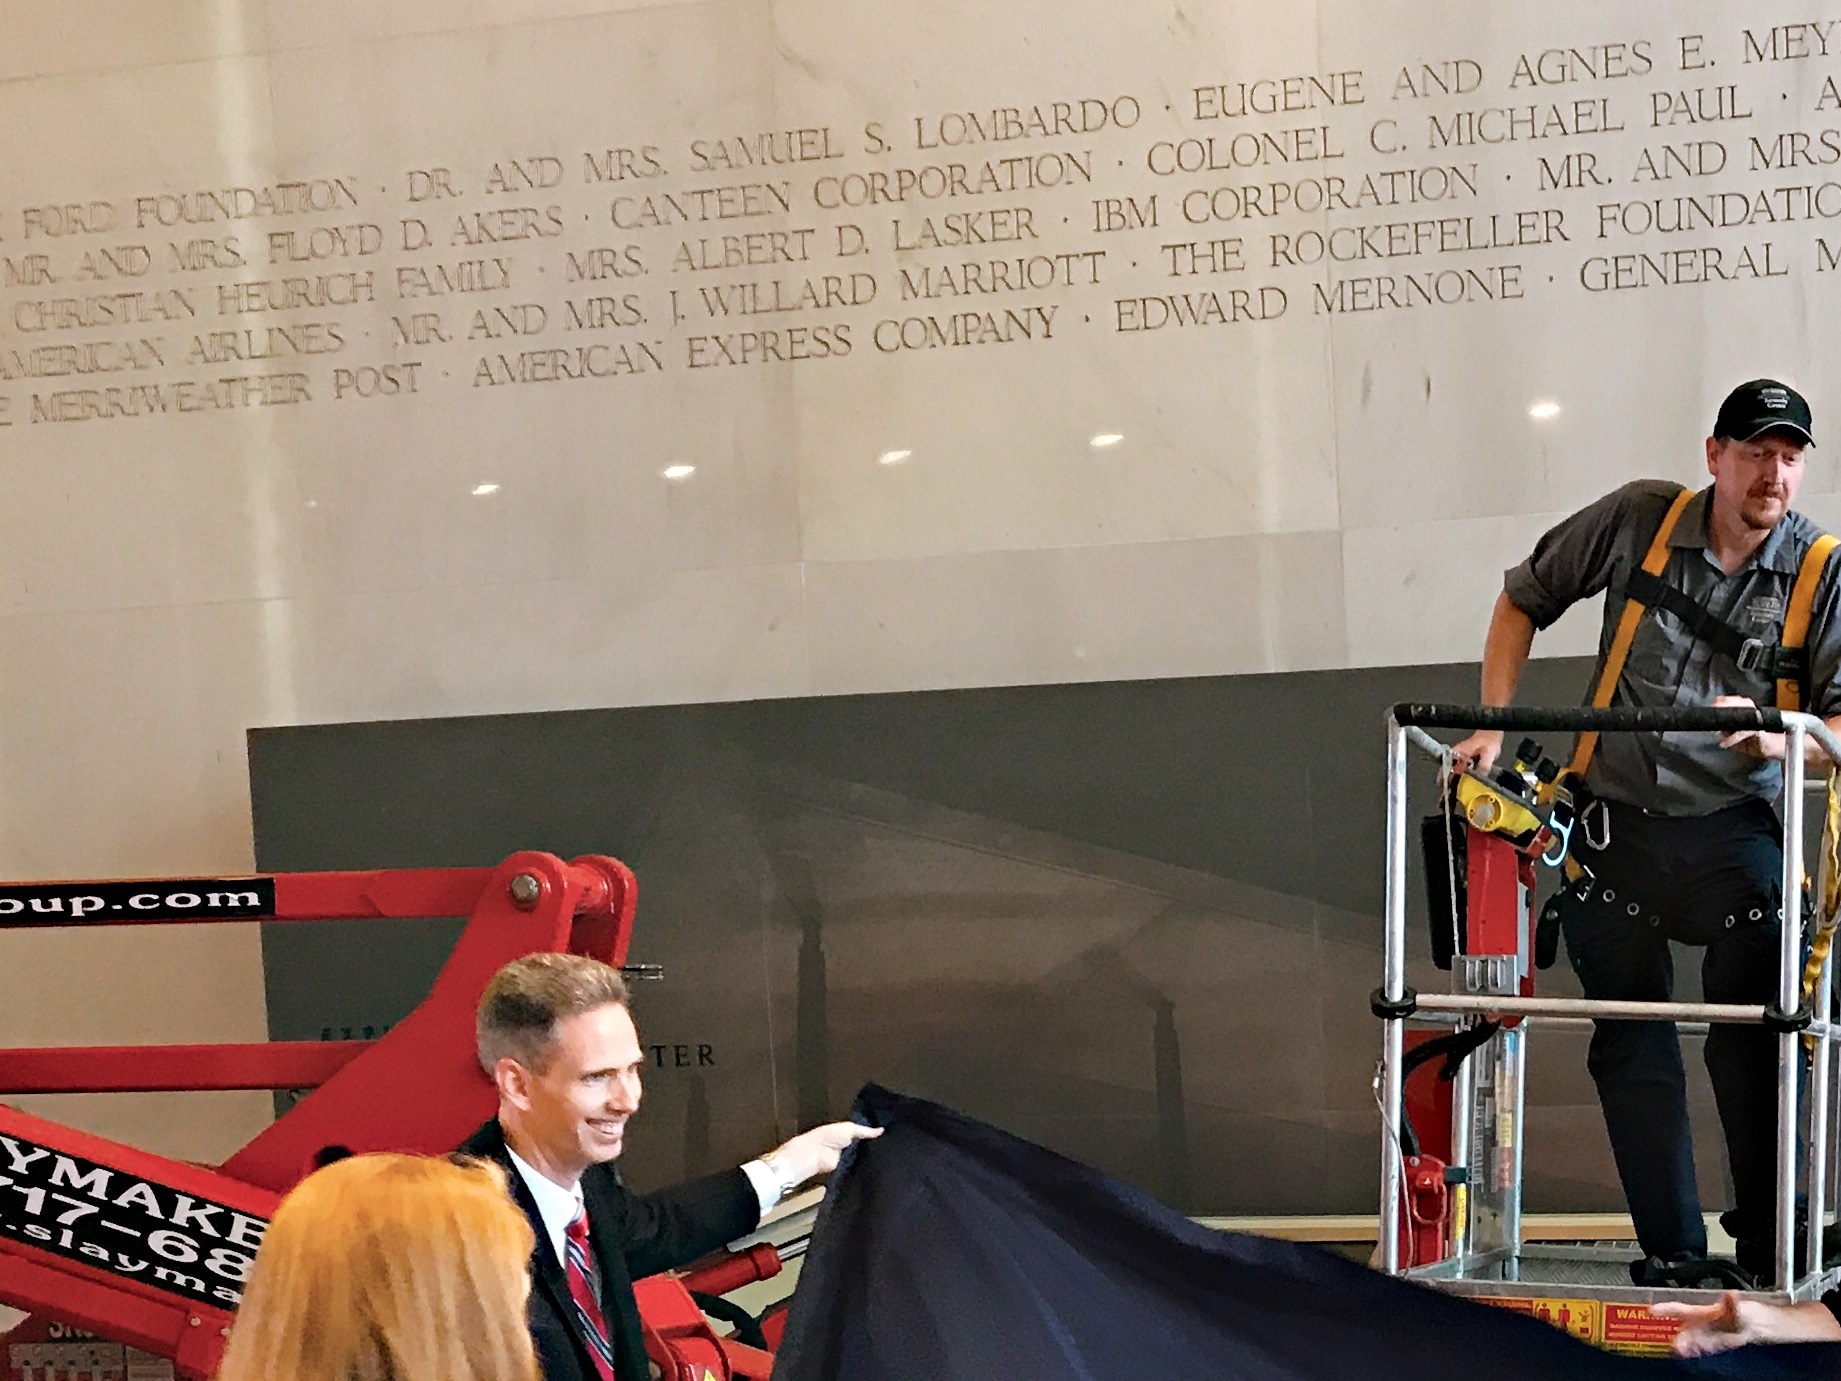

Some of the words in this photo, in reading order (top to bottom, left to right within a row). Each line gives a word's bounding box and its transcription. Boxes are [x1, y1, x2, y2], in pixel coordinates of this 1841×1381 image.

[22, 201, 117, 240] FORD
[135, 176, 358, 228] FOUNDATION
[406, 167, 463, 202] DR.
[485, 156, 564, 194] AND
[583, 145, 669, 184] MRS.
[689, 127, 844, 172] SAMUEL
[863, 122, 892, 153] S.
[914, 95, 1141, 150] LOMBARDO
[1193, 71, 1365, 121] EUGENE
[1391, 59, 1483, 101] AND
[1509, 40, 1653, 89] AGNES
[1678, 35, 1716, 70] E.
[75, 245, 151, 281] AND
[169, 236, 247, 273] MRS.
[267, 224, 383, 264] FLOYD
[400, 218, 433, 251] D.
[451, 205, 564, 246] AKERS
[610, 181, 791, 230] CANTEEN
[813, 150, 1093, 211] CORPORATION
[1147, 126, 1345, 175] COLONEL
[1369, 119, 1408, 154] C.
[1428, 98, 1626, 150] MICHAEL
[1649, 85, 1753, 128] PAUL
[14, 288, 196, 333] CHRISTIAN
[216, 270, 376, 315] HEURICH
[396, 257, 513, 299] FAMILY
[565, 244, 649, 283] MRS.
[671, 228, 816, 273] ALBERT
[837, 223, 870, 256] D.
[893, 207, 1040, 252] LASKER
[1092, 194, 1160, 233] IBM
[1182, 163, 1479, 225] CORPORATION
[1537, 151, 1613, 192] MR.
[1632, 140, 1728, 184] AND
[186, 322, 347, 366] AIRLINES
[391, 312, 454, 348] MR.
[467, 302, 549, 340] AND
[564, 293, 649, 332] MRS.
[668, 290, 686, 332] J.
[699, 271, 877, 319] WILLARD
[899, 250, 1107, 304] MARRIOTT
[1160, 238, 1245, 277] THE
[1271, 208, 1571, 268] ROCKEFELLER
[333, 361, 422, 400] POST
[472, 340, 664, 387] AMERICAN
[687, 324, 852, 369] EXPRESS
[872, 303, 1060, 354] COMPANY
[1115, 286, 1288, 334] EDWARD
[1312, 264, 1525, 315] MERNONE
[1579, 242, 1790, 292] GENERAL
[0, 891, 261, 917] oup.com
